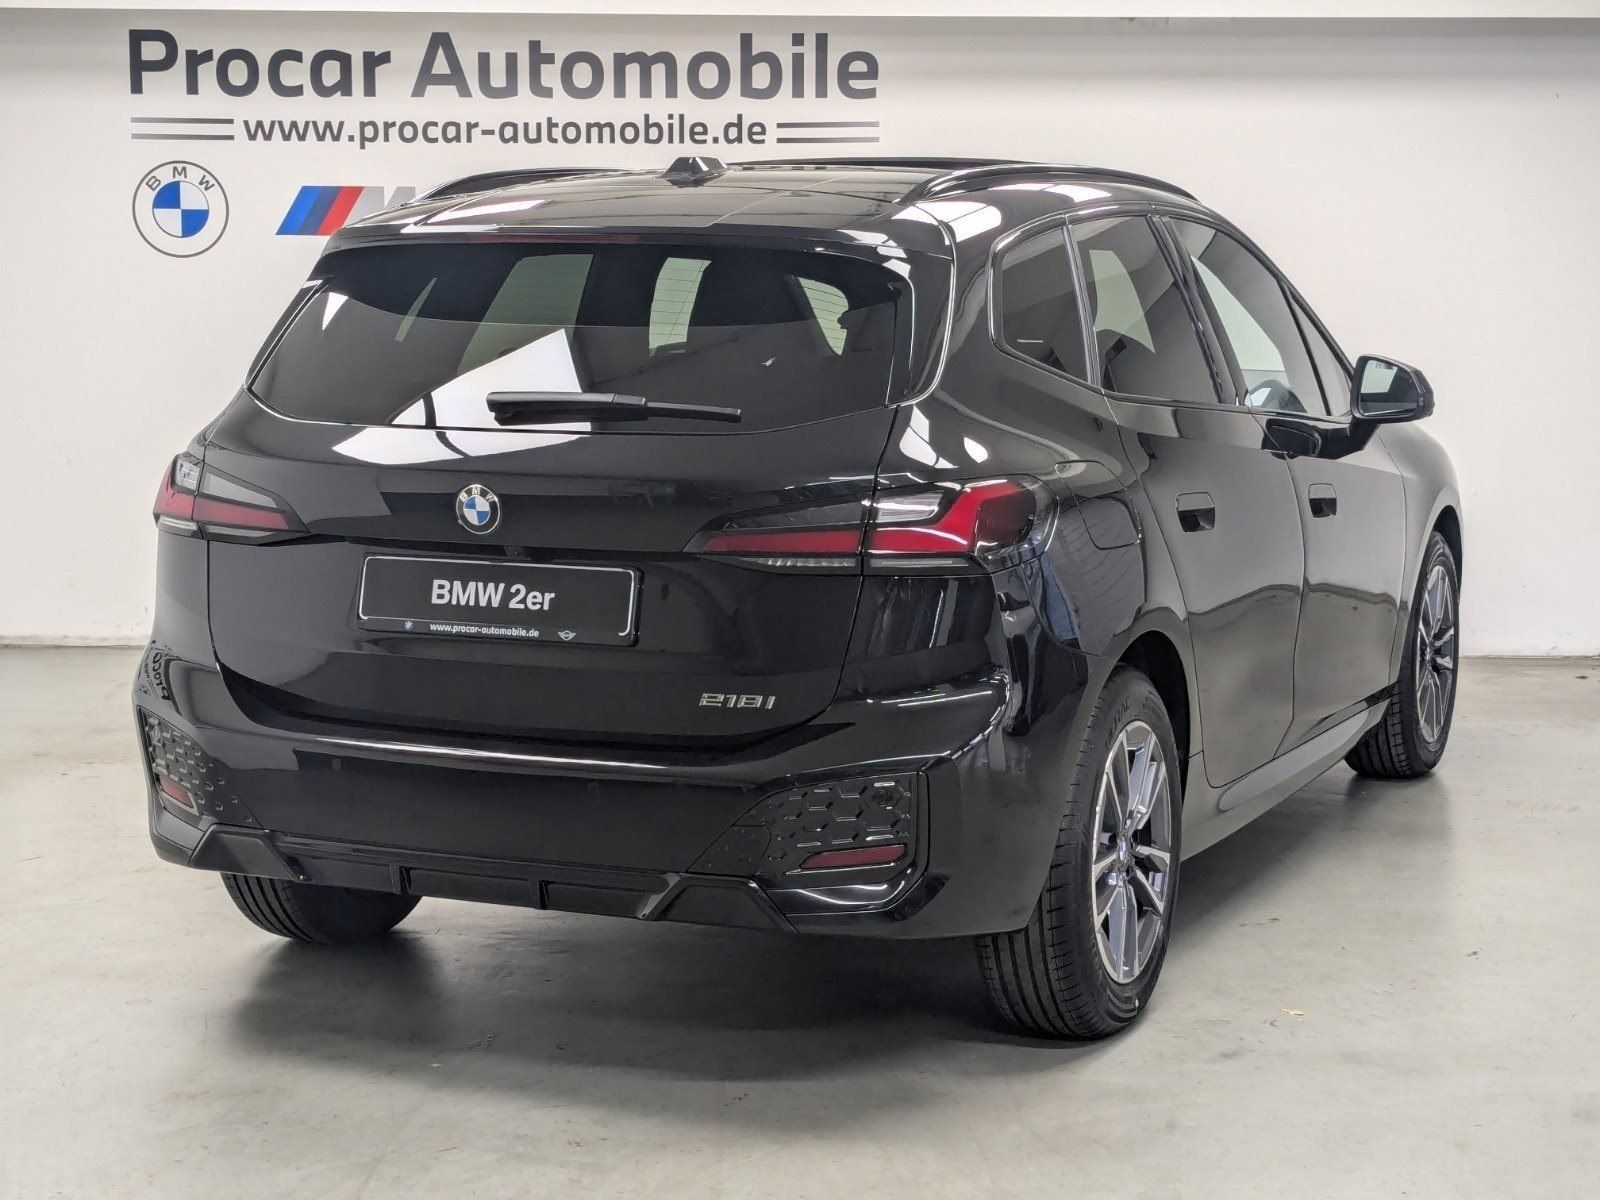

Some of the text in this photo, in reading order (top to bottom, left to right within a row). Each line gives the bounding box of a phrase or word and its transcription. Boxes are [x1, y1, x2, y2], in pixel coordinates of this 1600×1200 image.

[129, 28, 879, 100] Procar Automobile
[243, 113, 767, 149] www.procar-automobile.de
[145, 166, 216, 192] BMW
[460, 486, 495, 503] BMW
[431, 578, 555, 611] BMW 2er
[429, 622, 540, 638] www.procar-automobile.de
